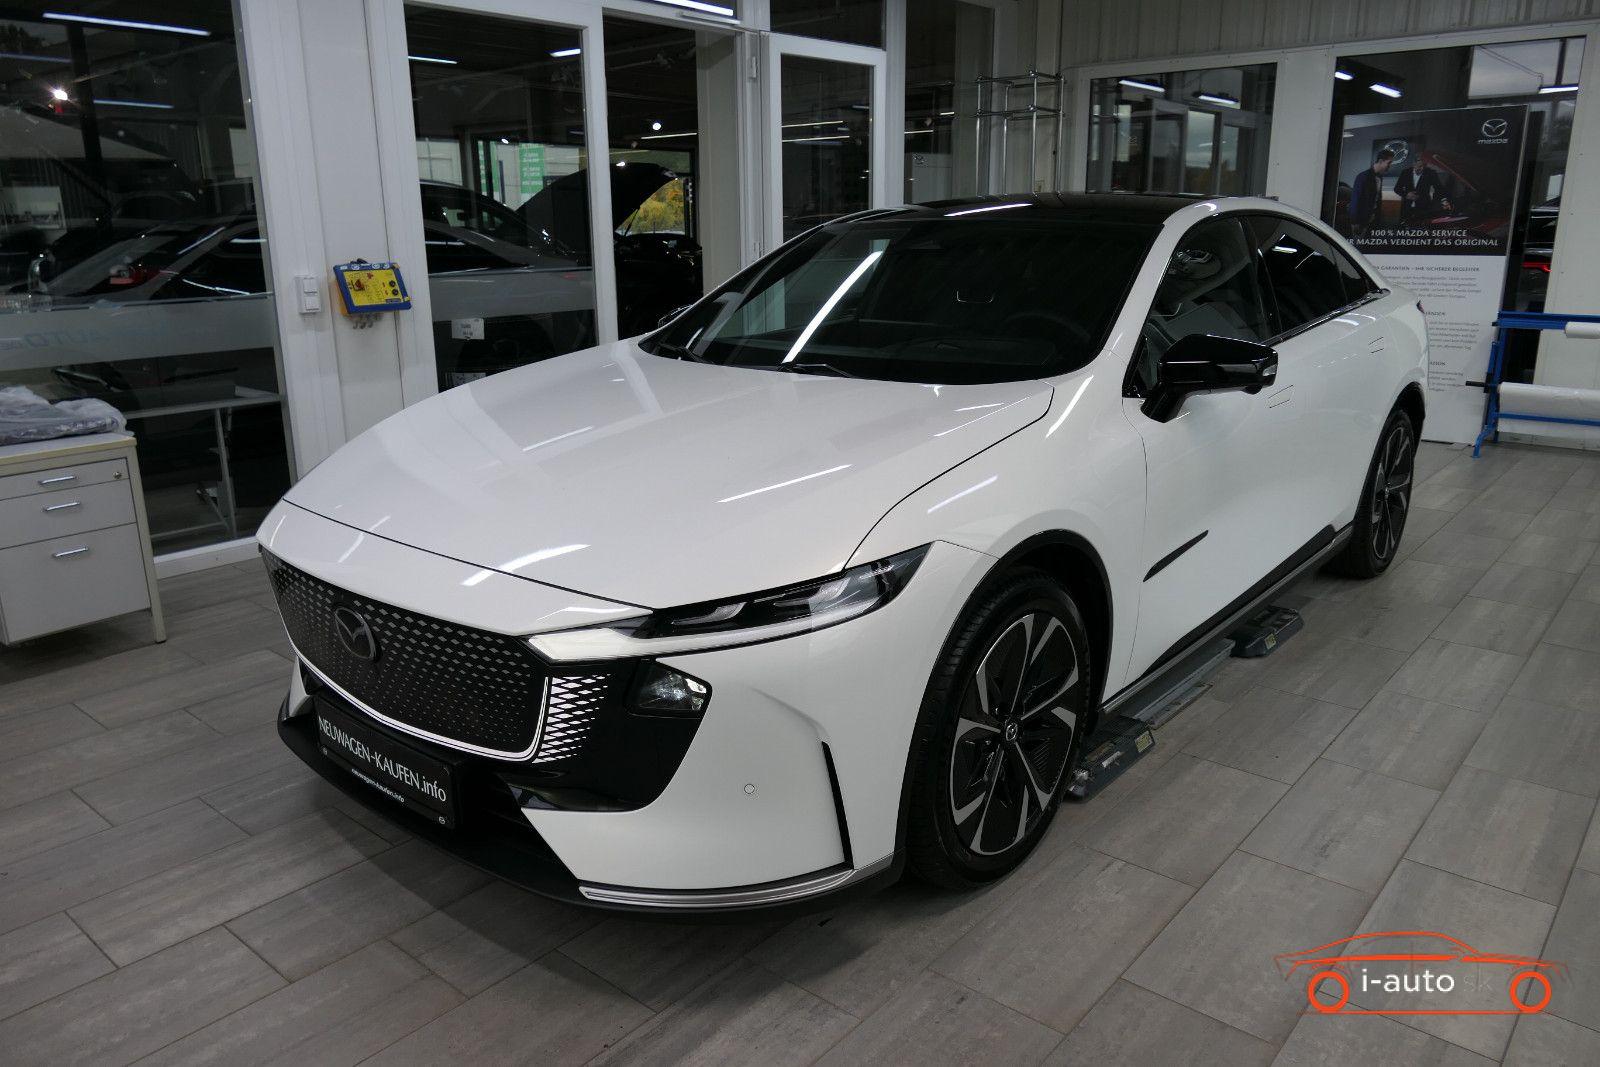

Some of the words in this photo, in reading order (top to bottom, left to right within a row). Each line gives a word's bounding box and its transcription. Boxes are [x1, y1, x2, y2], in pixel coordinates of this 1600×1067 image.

[1371, 229, 1386, 237] 100
[1396, 229, 1429, 237] MAZDA
[1432, 229, 1467, 237] SERVICE
[1390, 238, 1431, 246] VERDIENT
[318, 716, 446, 801] NEUWAGEN-KAUFEN.info
